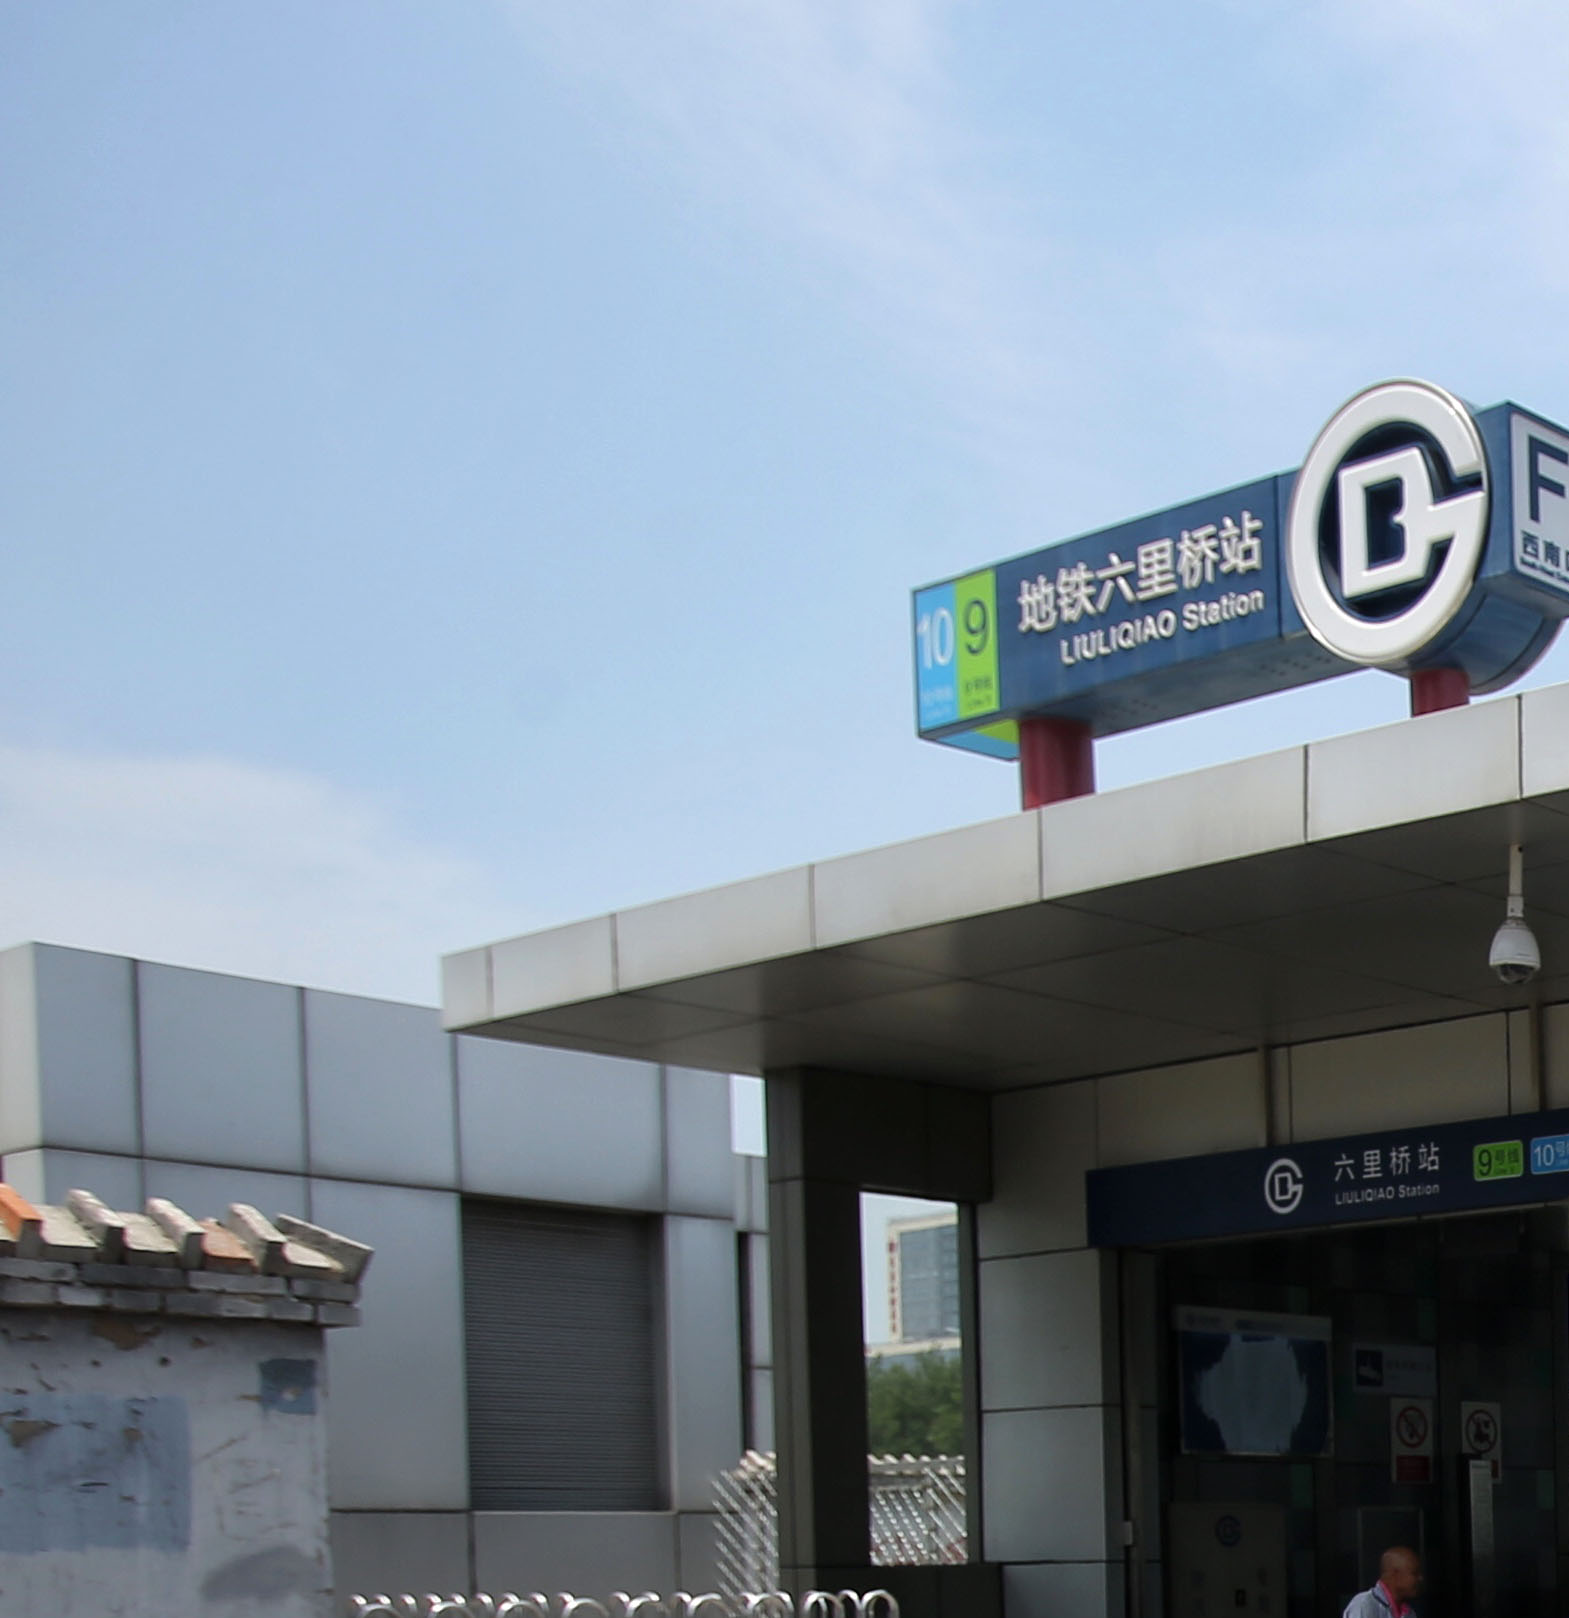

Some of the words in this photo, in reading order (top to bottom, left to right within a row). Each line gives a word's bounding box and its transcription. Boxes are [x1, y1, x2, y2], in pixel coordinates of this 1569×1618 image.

[1528, 433, 1569, 522] F
[1017, 510, 1263, 633] 地铁六里桥站
[917, 607, 954, 669] 10
[965, 599, 989, 655] 9
[1059, 609, 1177, 666] LIULIQIAO
[1182, 589, 1265, 631] Station
[1333, 1141, 1441, 1182] 六里桥站
[1334, 1187, 1395, 1206] LIULIQIAO
[1398, 1182, 1440, 1198] Station
